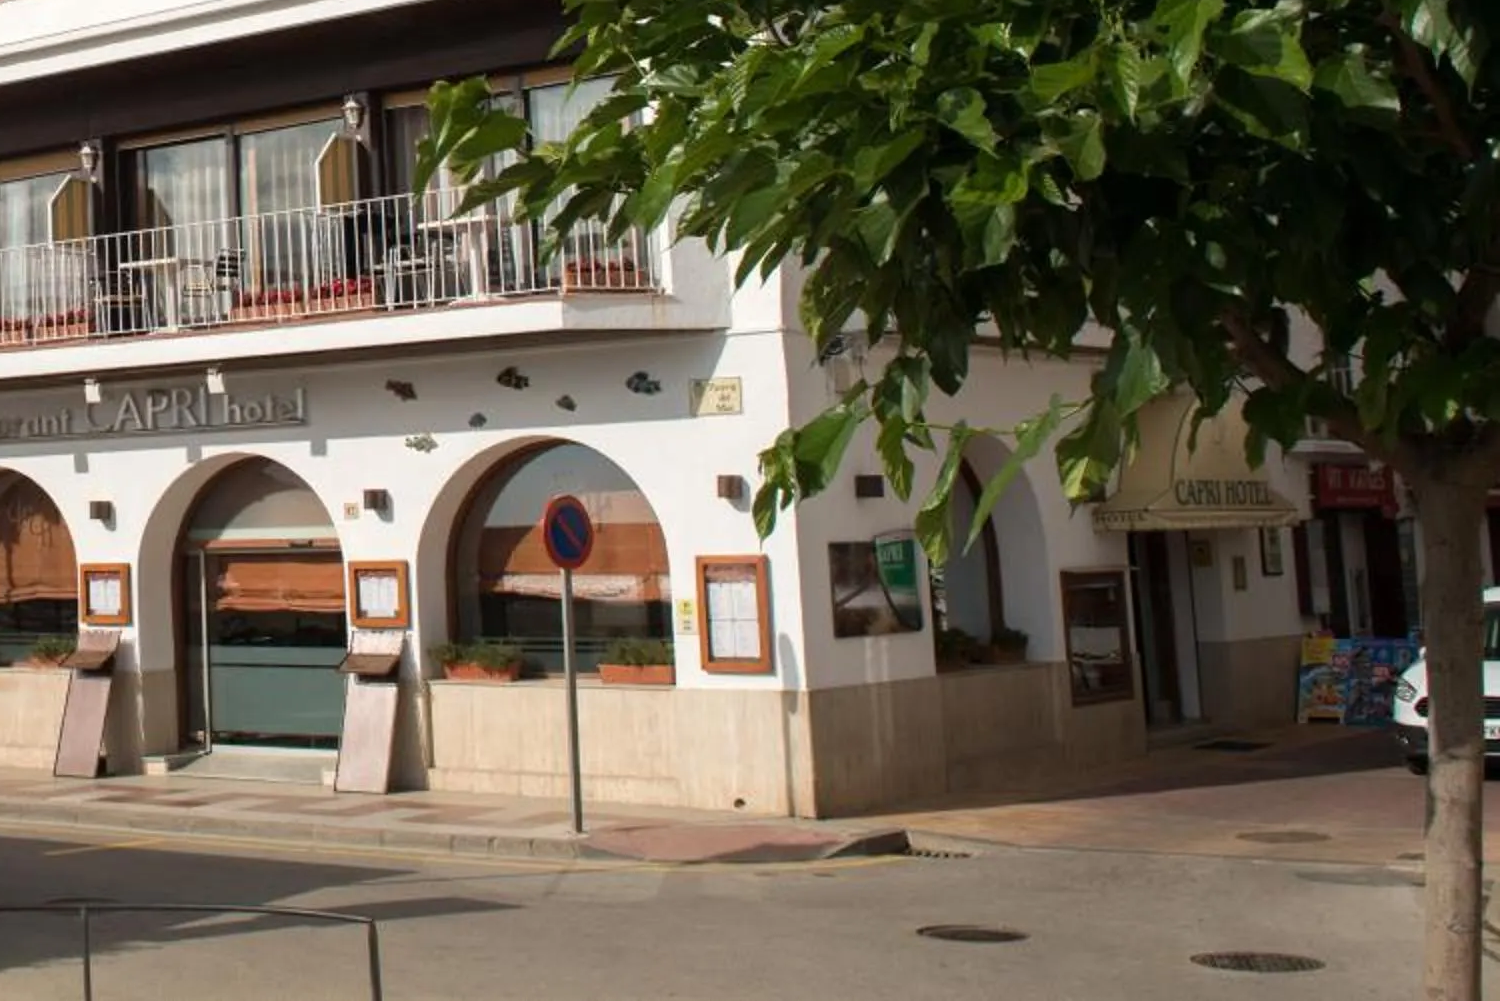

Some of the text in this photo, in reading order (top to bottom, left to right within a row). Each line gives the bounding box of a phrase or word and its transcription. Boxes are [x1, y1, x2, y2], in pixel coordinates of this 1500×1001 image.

[85, 385, 207, 433] CAPRI
[222, 386, 307, 425] hotel
[1174, 479, 1273, 506] CAPRI HOTEL
